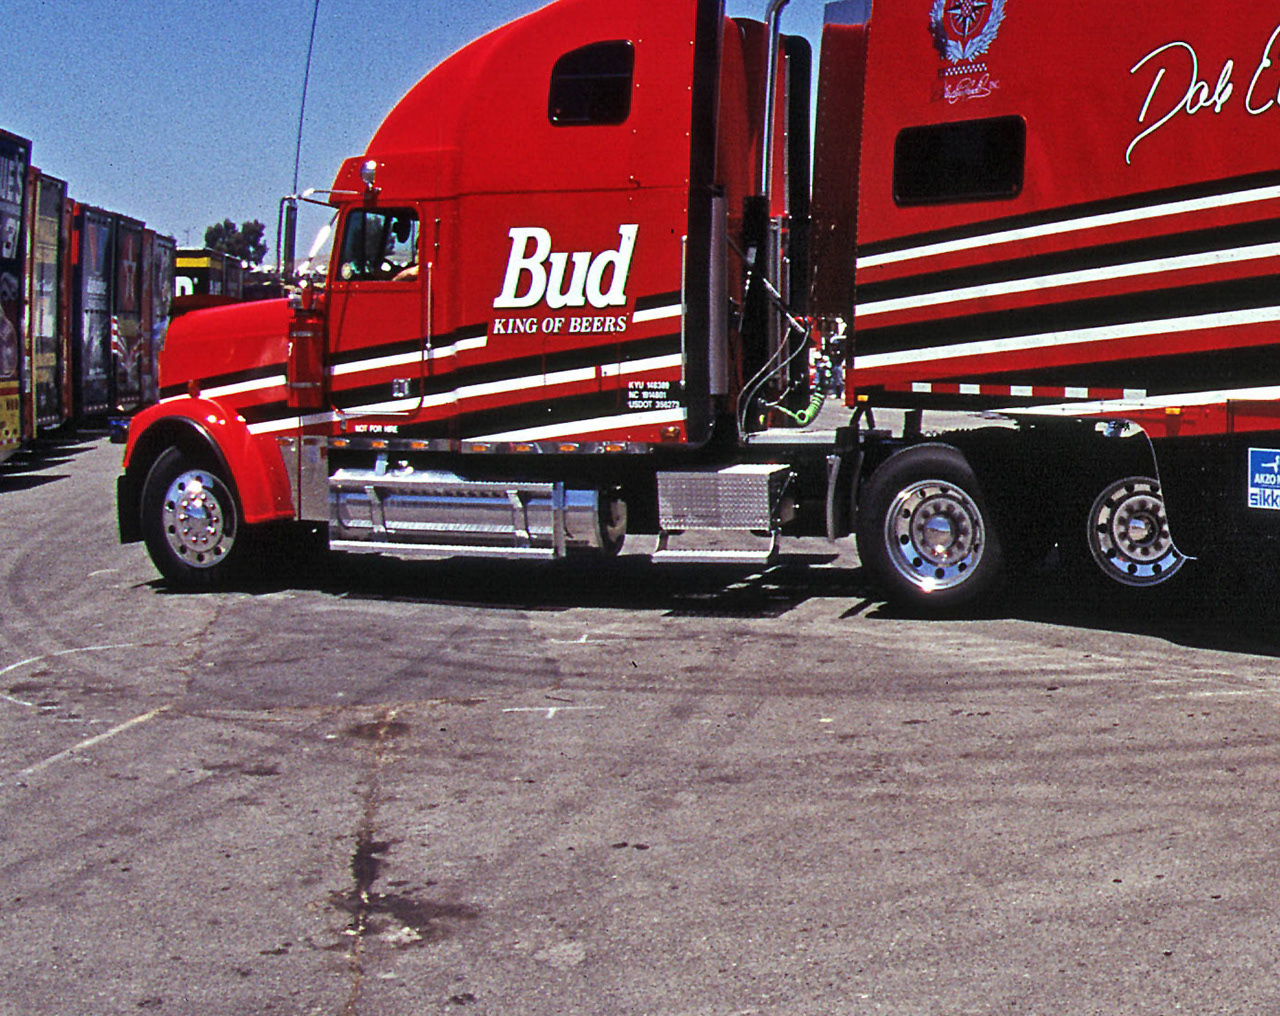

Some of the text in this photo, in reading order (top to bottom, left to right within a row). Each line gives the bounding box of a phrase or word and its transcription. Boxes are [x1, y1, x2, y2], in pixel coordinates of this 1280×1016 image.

[492, 224, 640, 309] Bud
[492, 316, 627, 334] KING OF BEERS
[627, 400, 652, 409] USDOT
[355, 424, 368, 432] NOT
[369, 424, 382, 433] FOR
[1254, 473, 1276, 485] AKZO
